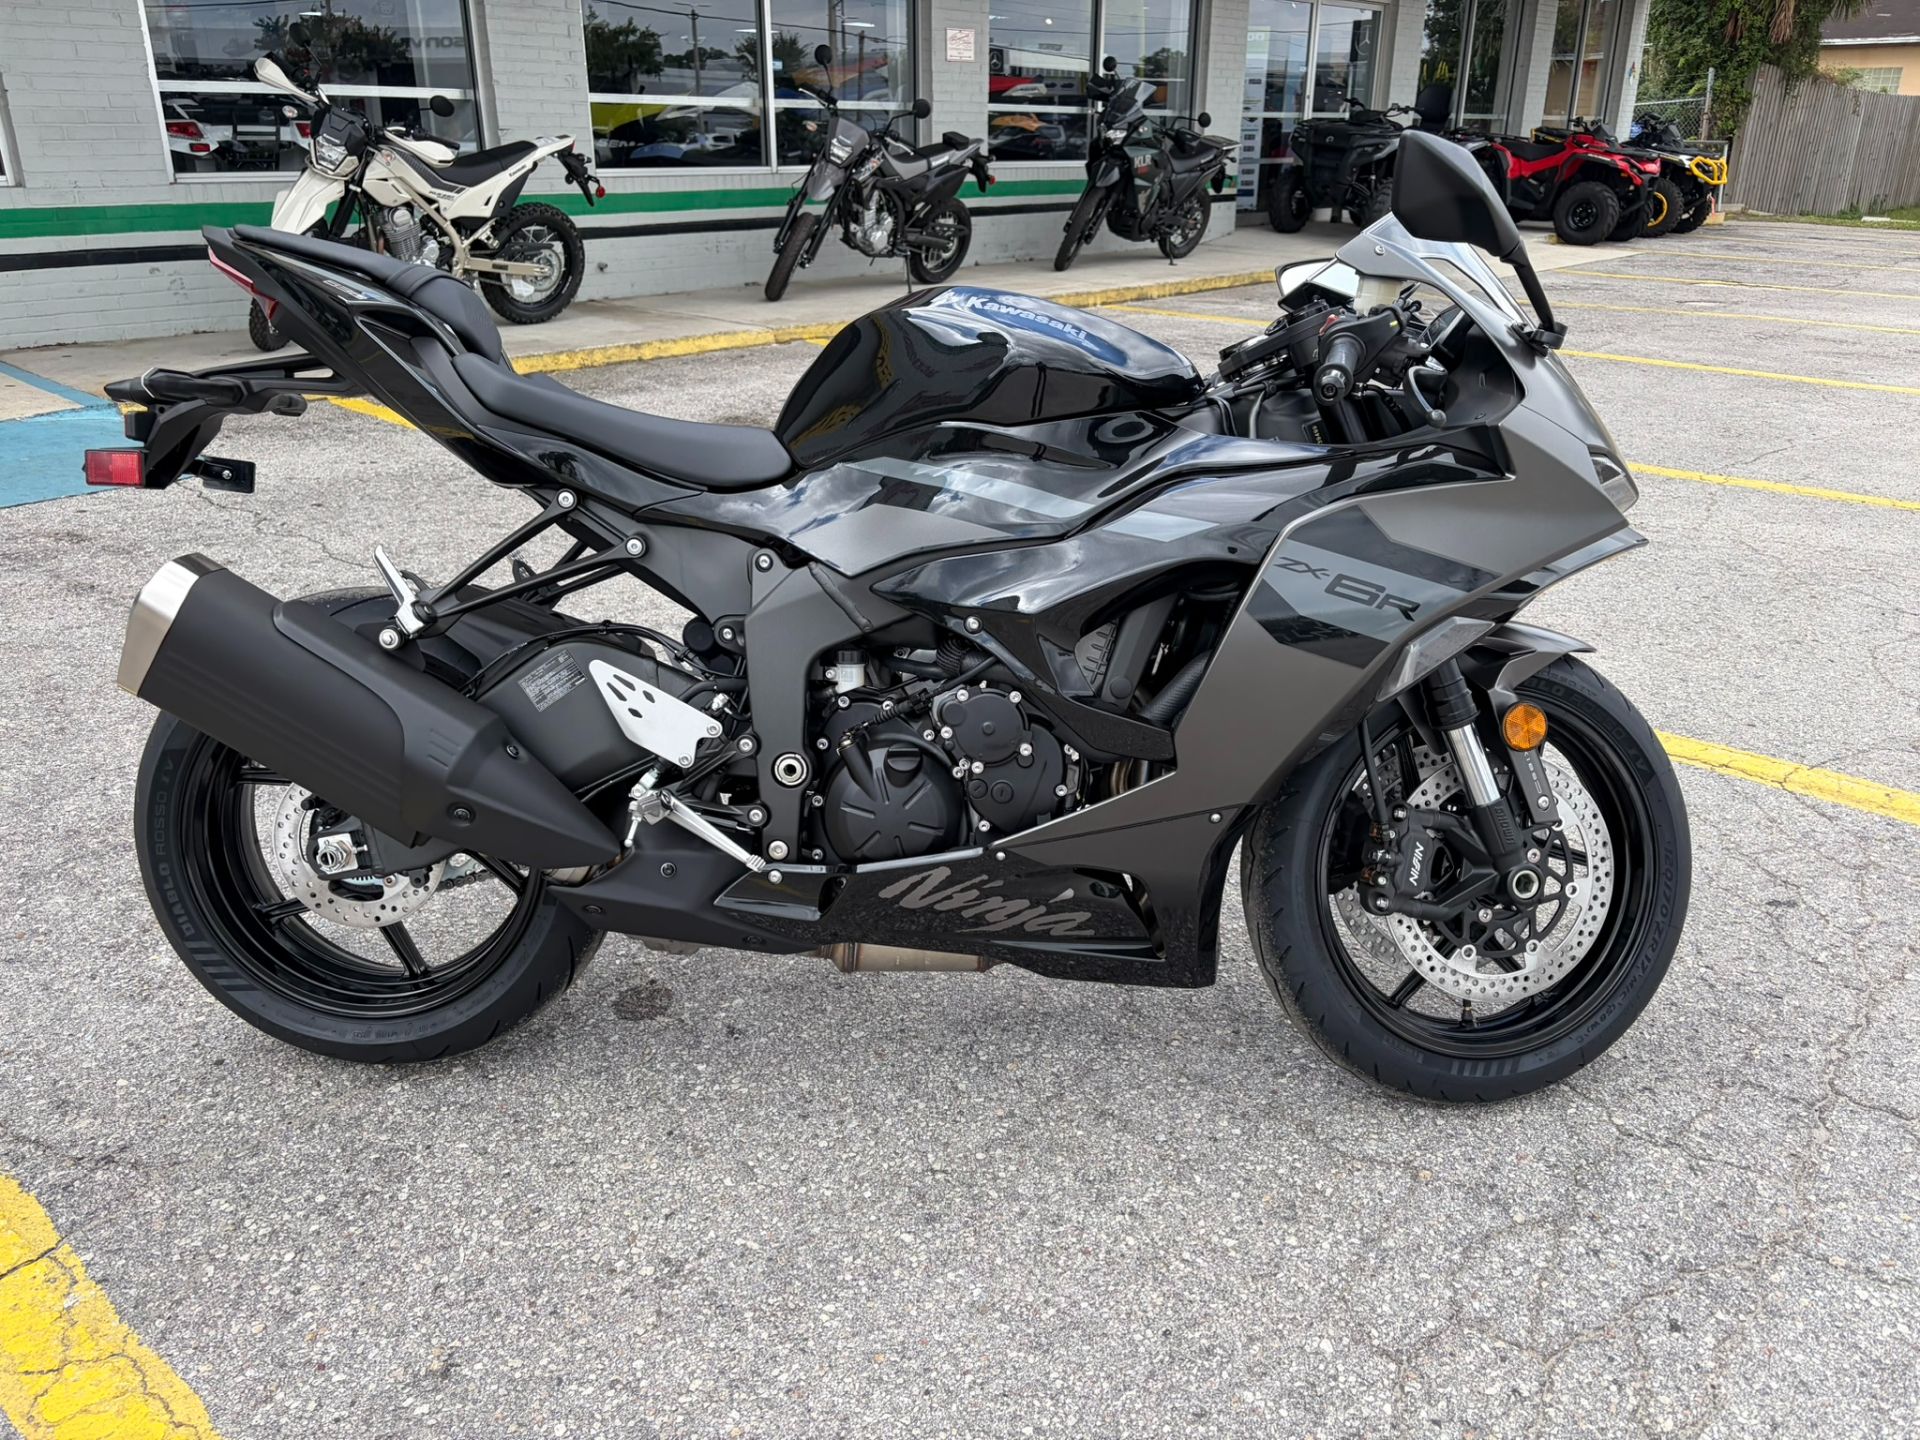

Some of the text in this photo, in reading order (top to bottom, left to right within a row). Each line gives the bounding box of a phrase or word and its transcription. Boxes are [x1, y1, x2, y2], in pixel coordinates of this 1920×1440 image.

[1134, 154, 1152, 168] KLR
[966, 296, 1087, 340] Kawasaki
[1273, 556, 1421, 622] ZX-6R
[154, 791, 169, 856] ROSSO
[1409, 841, 1425, 886] NISSIN
[158, 862, 194, 937] DIABLO
[878, 866, 1095, 936] Ninja
